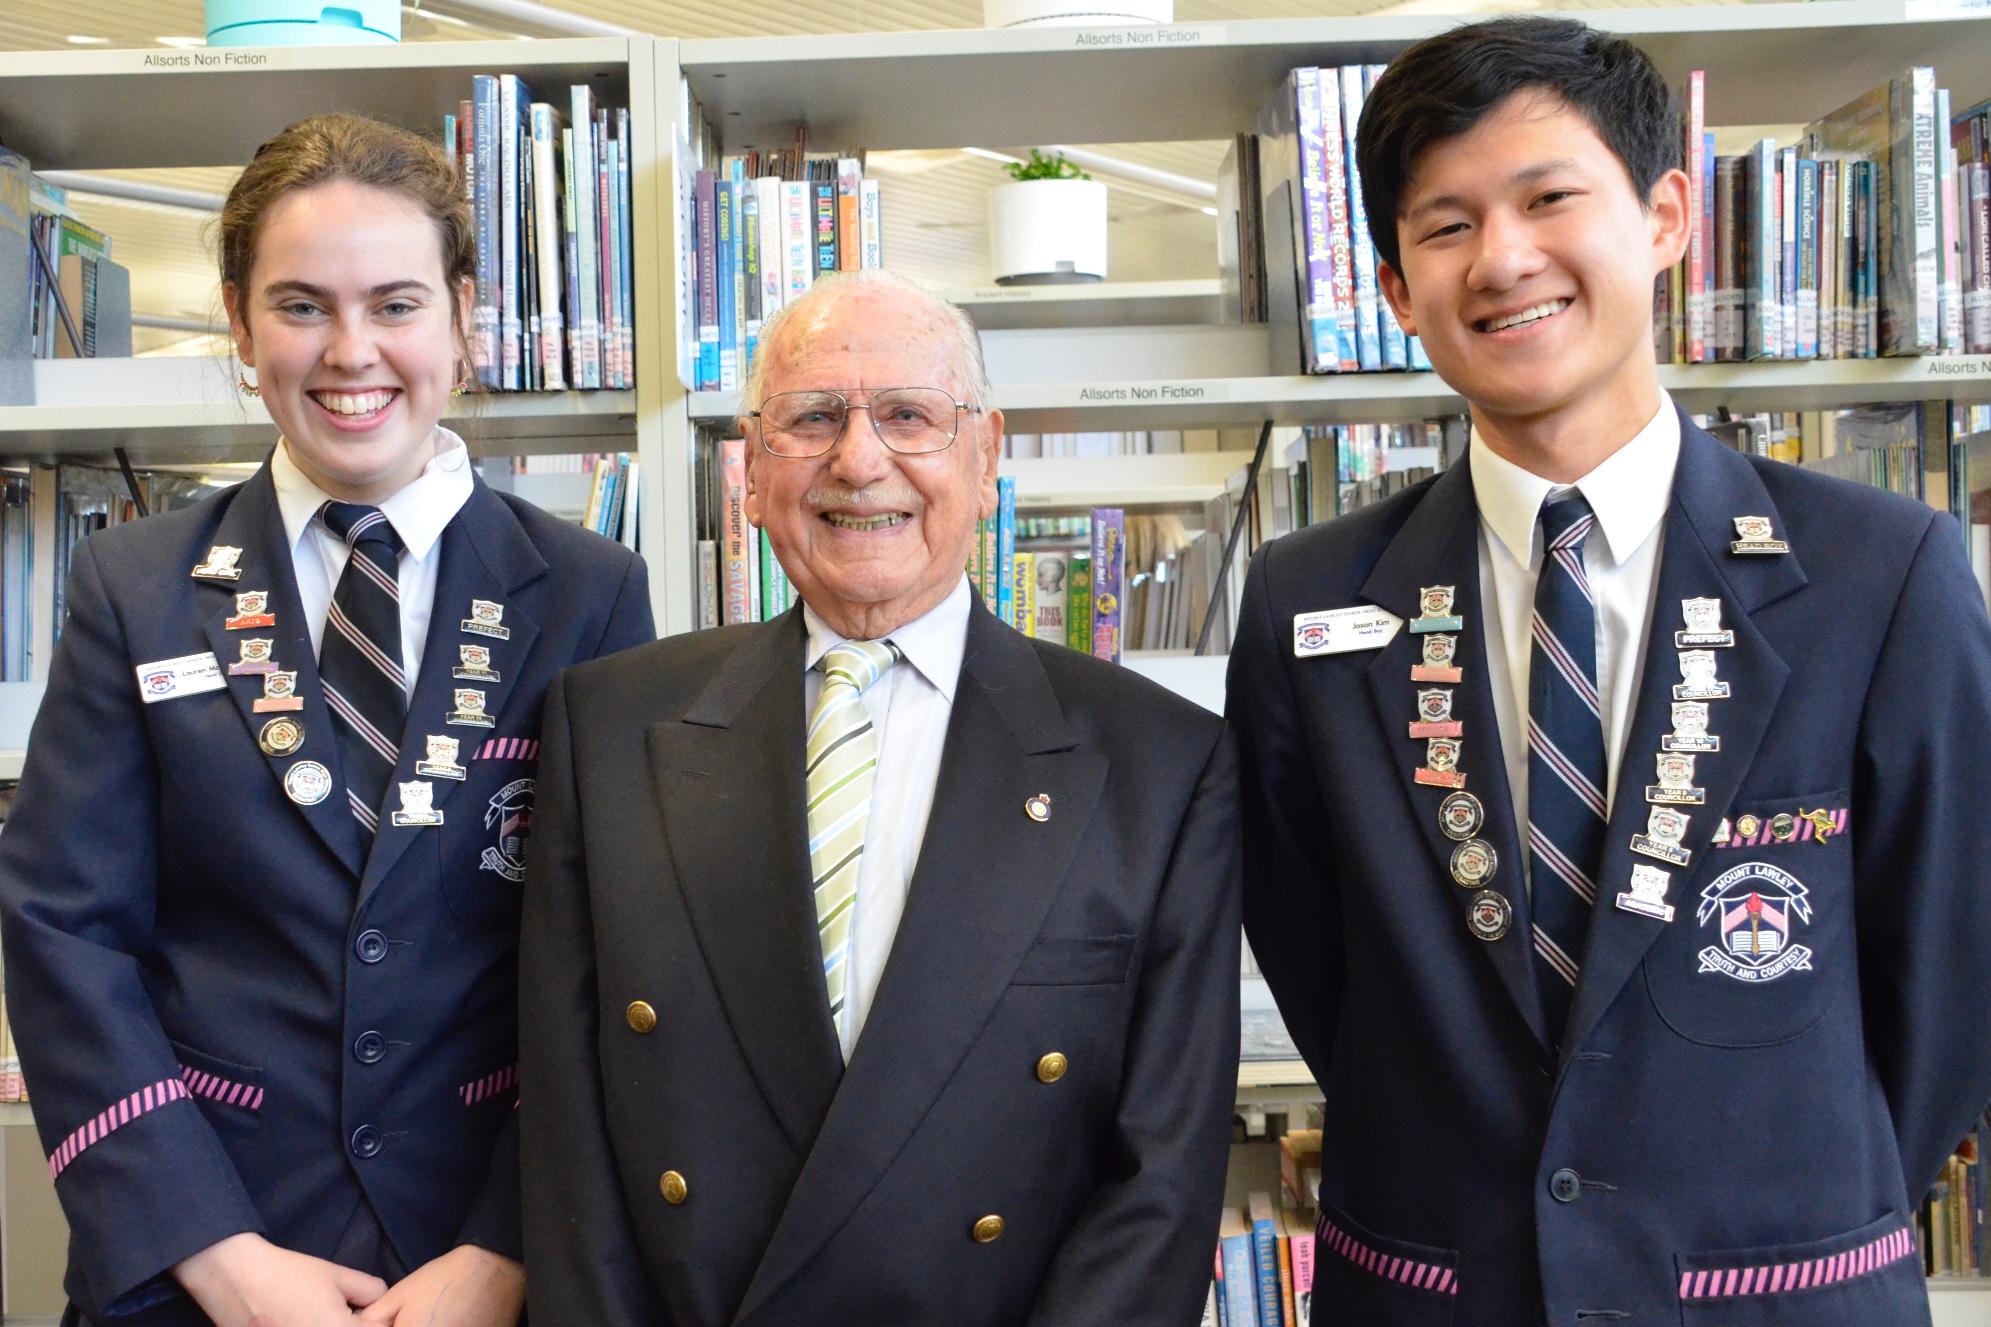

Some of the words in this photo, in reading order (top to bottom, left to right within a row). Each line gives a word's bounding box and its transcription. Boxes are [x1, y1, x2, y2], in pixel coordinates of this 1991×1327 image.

[1076, 31, 1125, 46] Allsorts
[1128, 31, 1154, 43] Non
[1158, 29, 1200, 42] Fiction
[144, 54, 191, 67] Allsorts
[194, 54, 221, 65] Non
[225, 52, 267, 64] Fiction
[477, 102, 491, 143] Formula
[478, 143, 491, 165] One
[719, 191, 729, 207] GET
[1328, 164, 1346, 220] WORLD
[1915, 172, 1935, 228] Animals
[865, 192, 876, 220] Boys
[720, 208, 730, 241] CODING!
[817, 197, 834, 243] ULTIMATE
[1312, 215, 1324, 230] or
[1981, 209, 1990, 234] LION
[746, 215, 757, 262] Photoshop
[1692, 232, 1702, 263] FIRST
[819, 244, 835, 268] TEEN
[1332, 223, 1352, 297] RECORDS
[1982, 235, 1991, 272] CALLED
[704, 251, 712, 294] GREATEST
[1929, 361, 1977, 374] Allsorts
[1081, 389, 1127, 400] Allsorts
[1131, 387, 1157, 399] Non
[1161, 385, 1204, 398] Fiction
[1097, 520, 1107, 548] Believe
[985, 531, 997, 572] Believe
[730, 560, 747, 624] SAVAGE
[1037, 616, 1063, 627] BOOK
[1039, 606, 1061, 616] THIS
[467, 622, 503, 636] PREFECT
[1352, 621, 1373, 630] Jason
[1375, 619, 1390, 627] Kim
[1682, 633, 1726, 645] PREFECT
[182, 667, 207, 678] Lauren
[1669, 742, 1711, 751] COUNCILLOR
[500, 780, 527, 801] MOUNT
[1654, 794, 1696, 802] COUNCILLOR
[1662, 788, 1681, 796] YEAR
[1636, 843, 1682, 863] COUNCILLOR
[488, 851, 506, 873] TRUTH
[505, 868, 519, 880] AND
[1715, 865, 1751, 891] MOUNT
[1754, 865, 1795, 889] LAWLEY
[1707, 949, 1735, 974] TRUTH
[1736, 966, 1758, 980] AND
[1759, 947, 1802, 980] COURTESY
[1258, 1226, 1275, 1271] VEILED
[1299, 1241, 1310, 1258] leah
